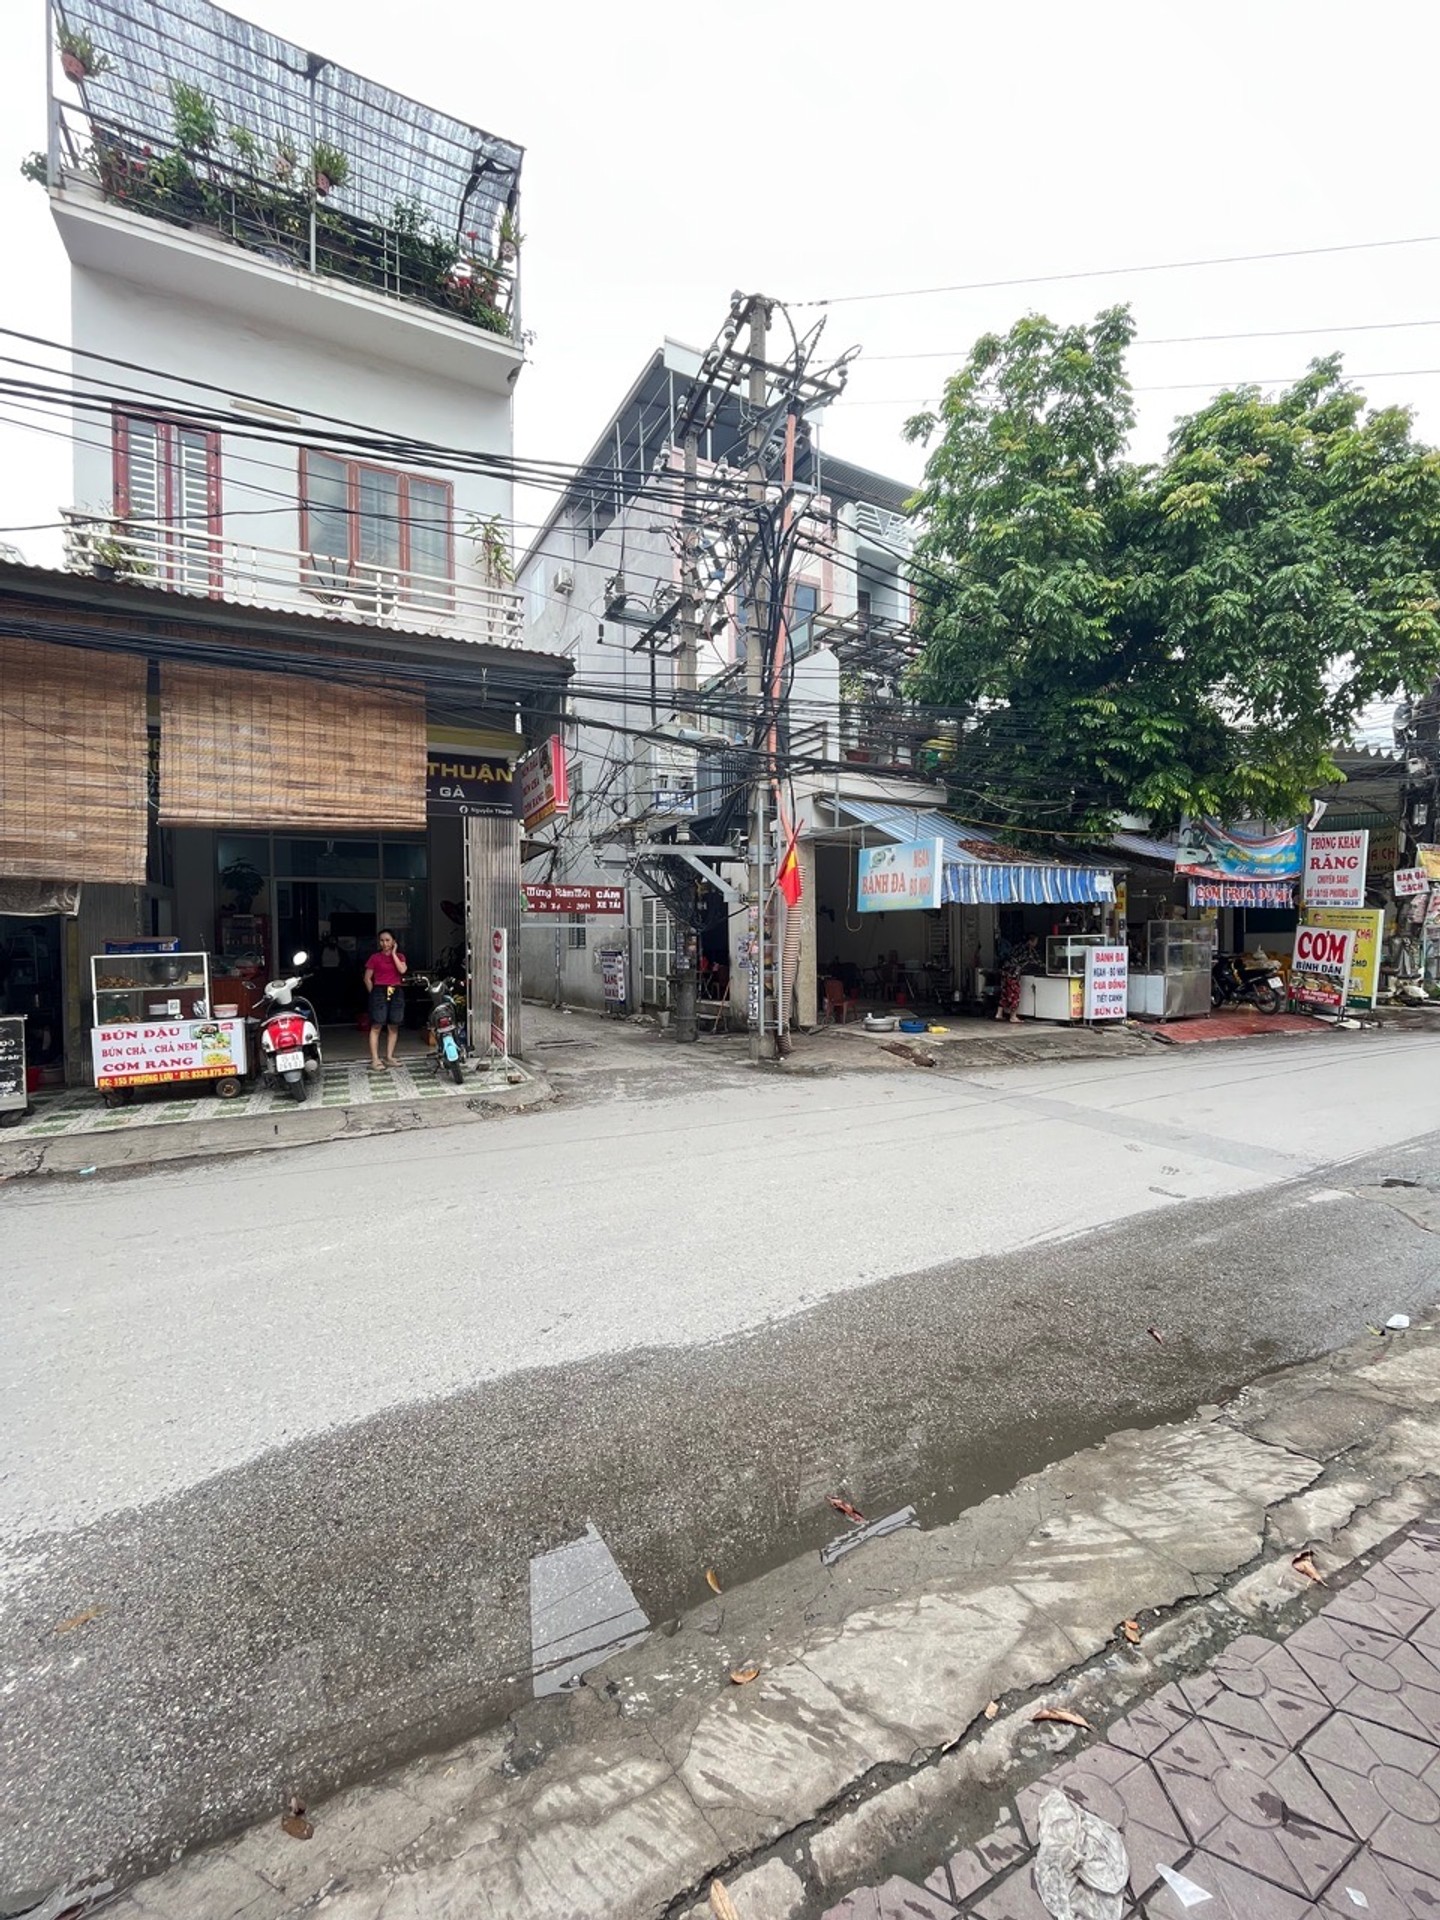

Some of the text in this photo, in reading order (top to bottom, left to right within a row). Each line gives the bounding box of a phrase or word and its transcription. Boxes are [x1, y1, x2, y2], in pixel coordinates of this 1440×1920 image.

[427, 762, 513, 783] THUẬN
[1311, 834, 1336, 850] PHÒNG
[1338, 832, 1362, 849] KHÁM
[1310, 853, 1359, 870] RĂNG
[862, 870, 906, 895] BÁNH ĐA
[595, 888, 621, 899] CẤM
[596, 901, 607, 909] XE
[1298, 930, 1347, 964] CƠM
[1296, 961, 1342, 975] BÌNH DÂN
[101, 1028, 138, 1041] BÚN
[102, 1046, 122, 1058] BÚN
[126, 1043, 147, 1056] CHẢ
[155, 1041, 175, 1054] CHẢ
[177, 1042, 198, 1052] NEM
[103, 1057, 194, 1073] CƠM RANG
[128, 1073, 158, 1085] PHƯƠNG
